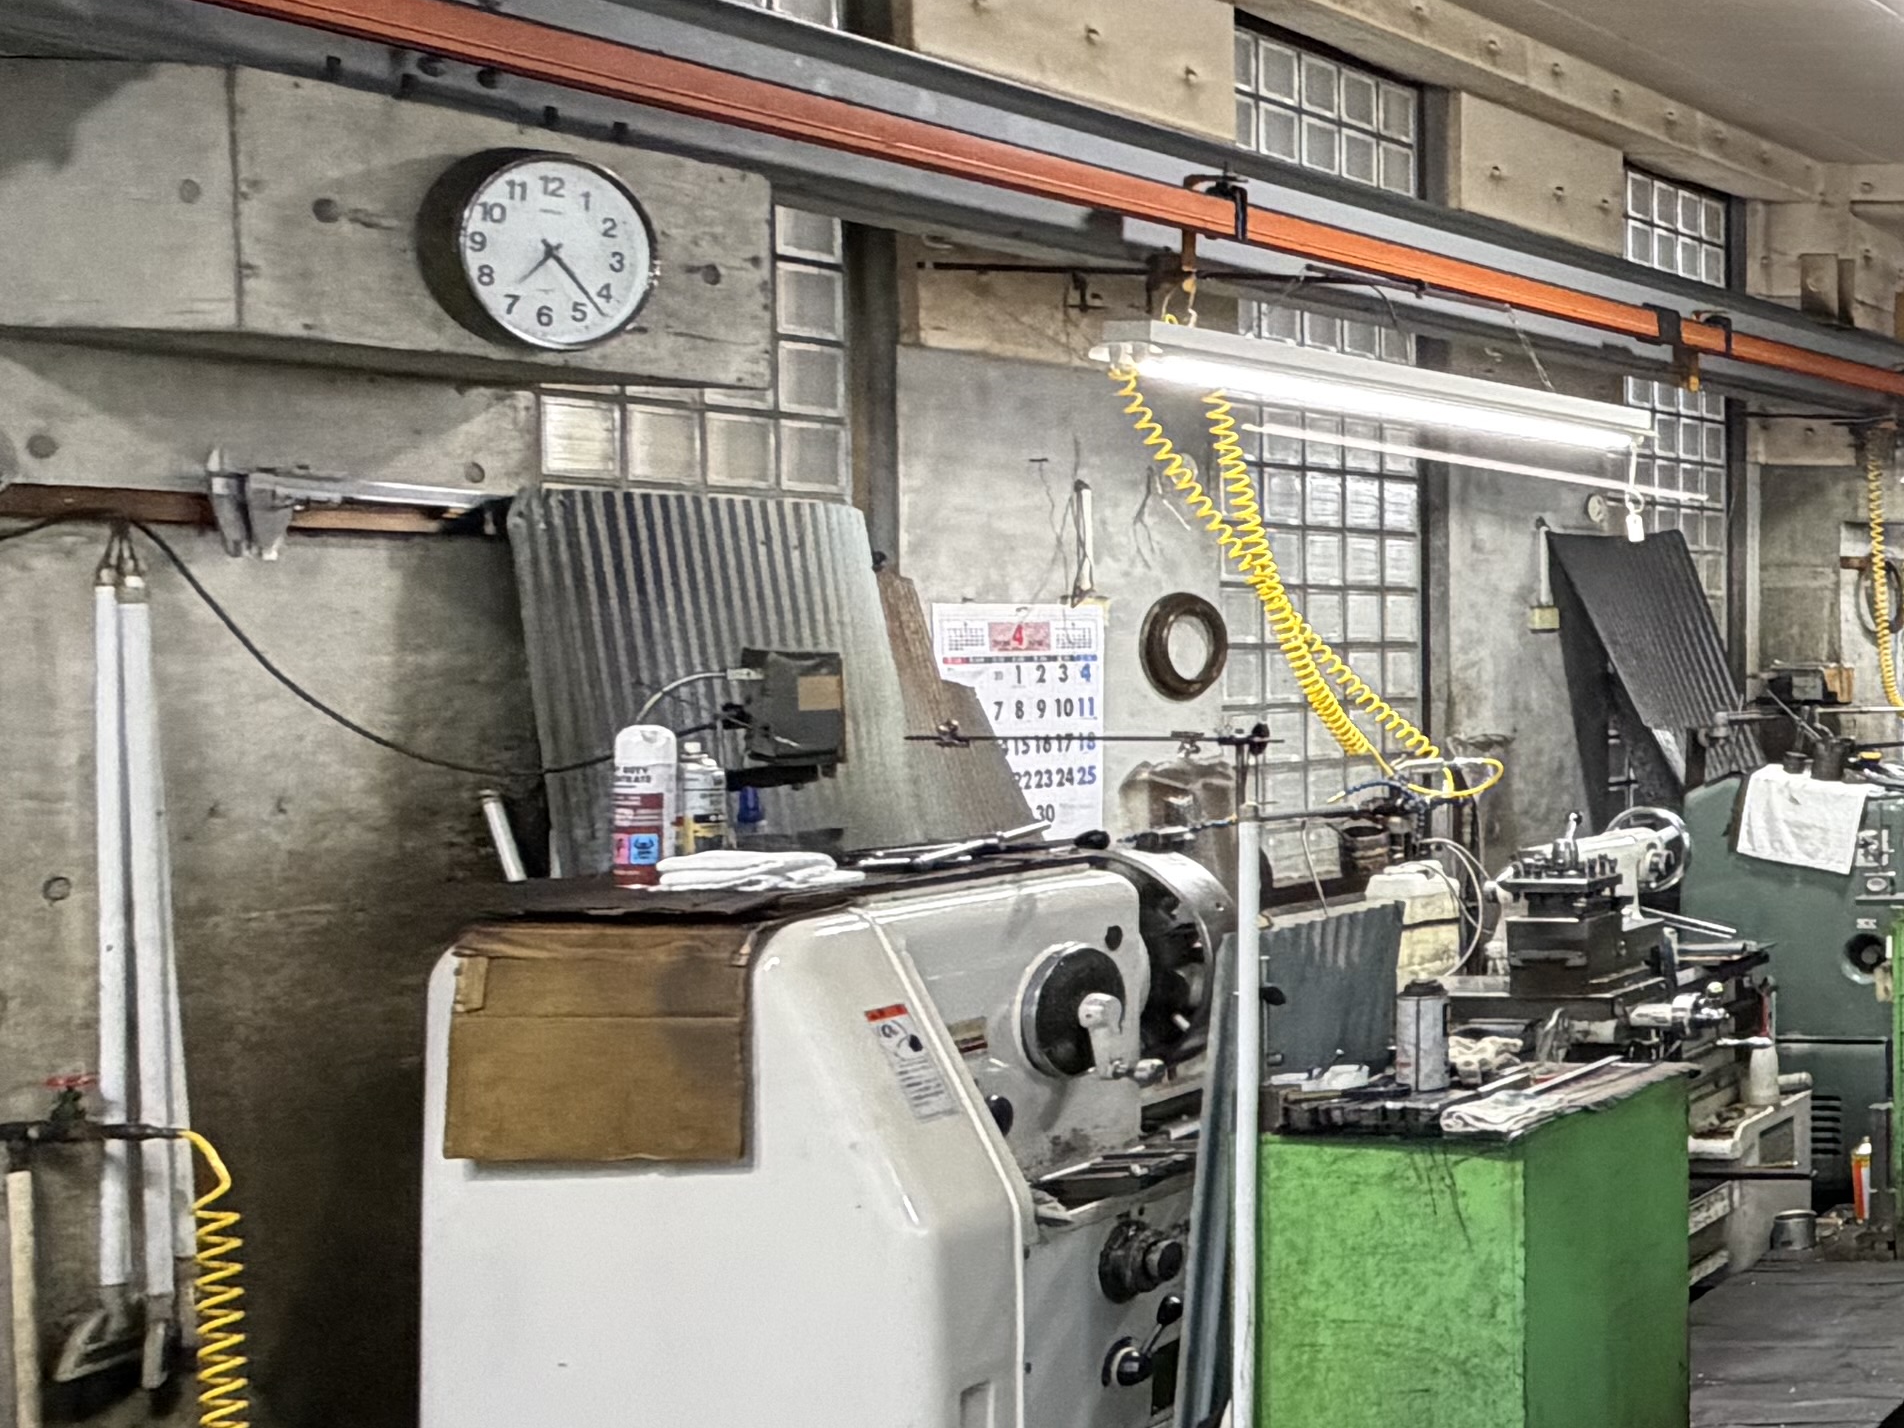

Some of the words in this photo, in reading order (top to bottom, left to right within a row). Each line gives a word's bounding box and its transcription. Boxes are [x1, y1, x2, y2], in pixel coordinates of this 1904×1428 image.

[505, 179, 528, 201] 11
[538, 175, 565, 198] 12
[478, 201, 507, 223] 10
[580, 191, 591, 212] 1
[602, 217, 617, 238] 2
[468, 231, 487, 252] 9
[609, 251, 625, 273] 3
[477, 264, 495, 286] 8
[597, 283, 613, 303] 4
[503, 294, 520, 315] 7
[571, 302, 587, 322] 5
[536, 305, 553, 326] 6
[1012, 624, 1024, 645] 4
[1016, 665, 1022, 684] 1
[1036, 665, 1046, 683] 2
[1058, 664, 1068, 682] 3
[1081, 664, 1091, 682] 4
[994, 701, 1003, 721] 7
[1015, 700, 1024, 719] 8
[1036, 699, 1046, 719] 9
[1055, 698, 1073, 717] 10
[1078, 697, 1094, 717] 11
[1035, 770, 1053, 789] 23
[1056, 768, 1074, 787] 24
[1077, 766, 1096, 785] 25
